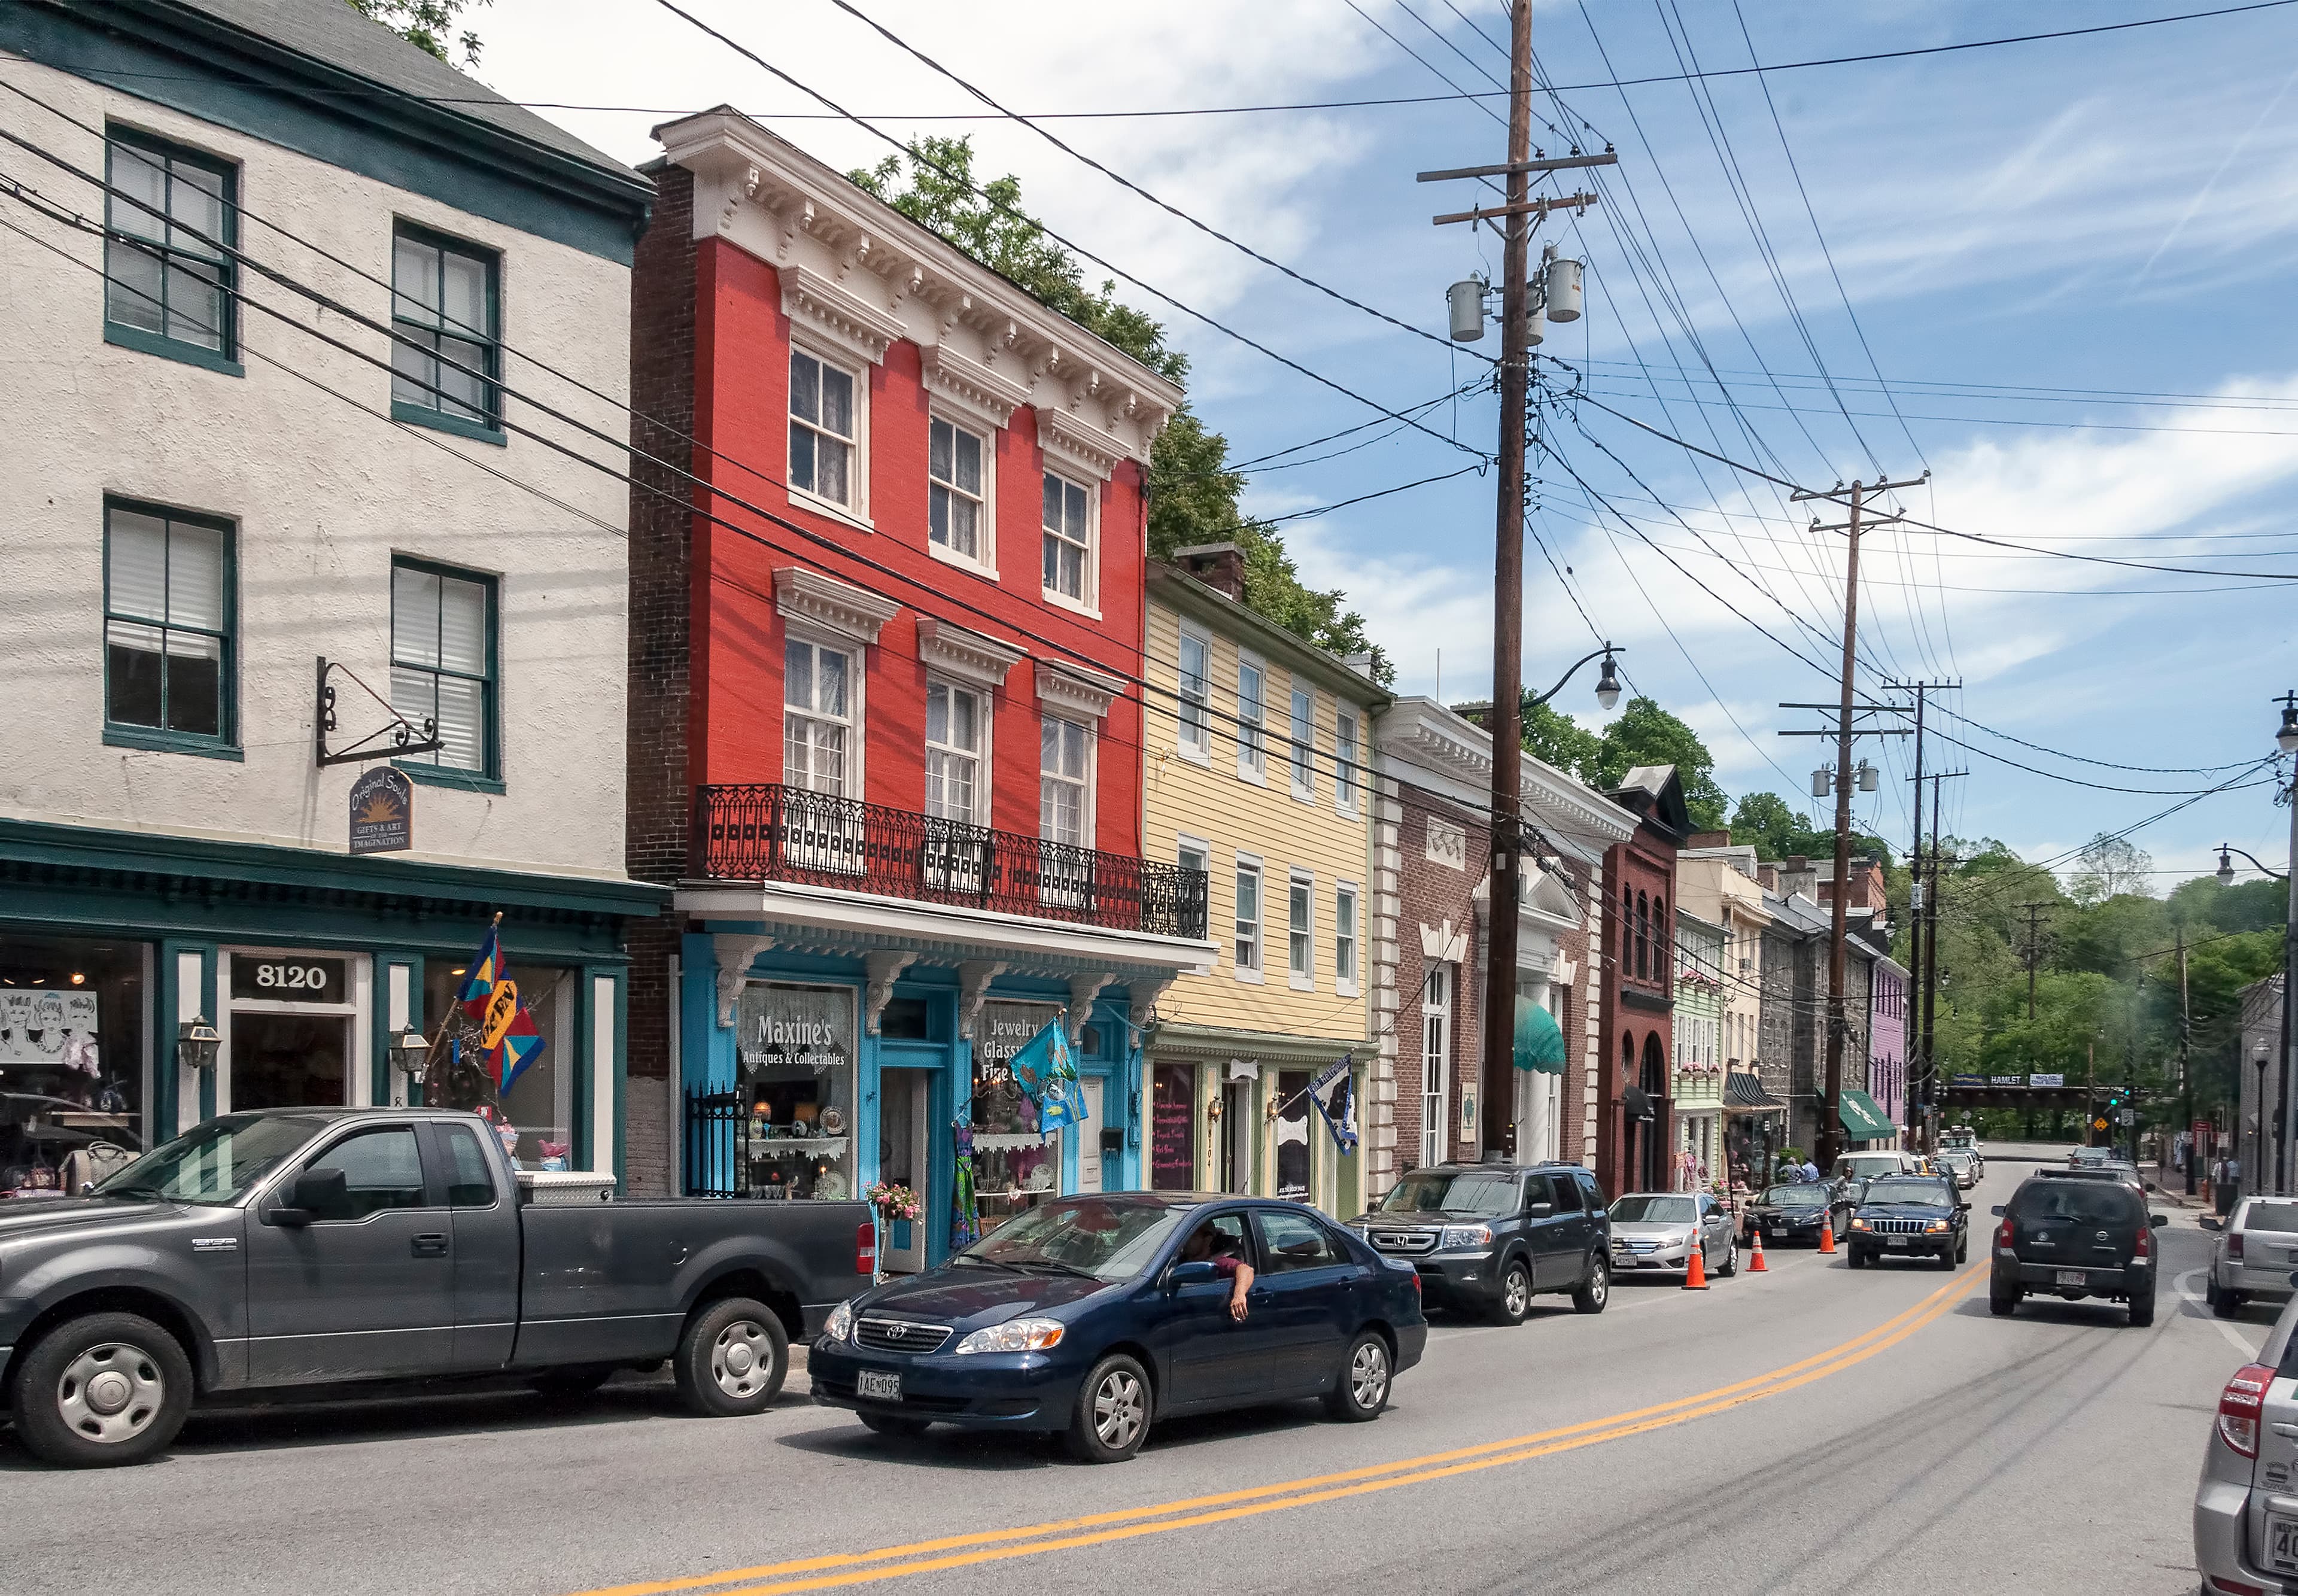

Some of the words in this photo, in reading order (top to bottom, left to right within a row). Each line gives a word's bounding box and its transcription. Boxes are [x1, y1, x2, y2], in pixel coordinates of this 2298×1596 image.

[351, 773, 385, 811] Original
[385, 774, 408, 805] Souls
[357, 826, 378, 834] GIFTS
[386, 822, 402, 831] ART
[354, 836, 405, 849] IMAGINATION
[256, 964, 327, 989] 8120
[481, 982, 515, 1044] OPEN
[758, 1016, 832, 1046] Maxine's
[991, 1019, 1039, 1038] Jewelry
[743, 1050, 783, 1066] Antiques
[785, 1052, 792, 1064] &
[794, 1051, 845, 1066] Collectables
[1991, 1075, 2022, 1085] HAMLET
